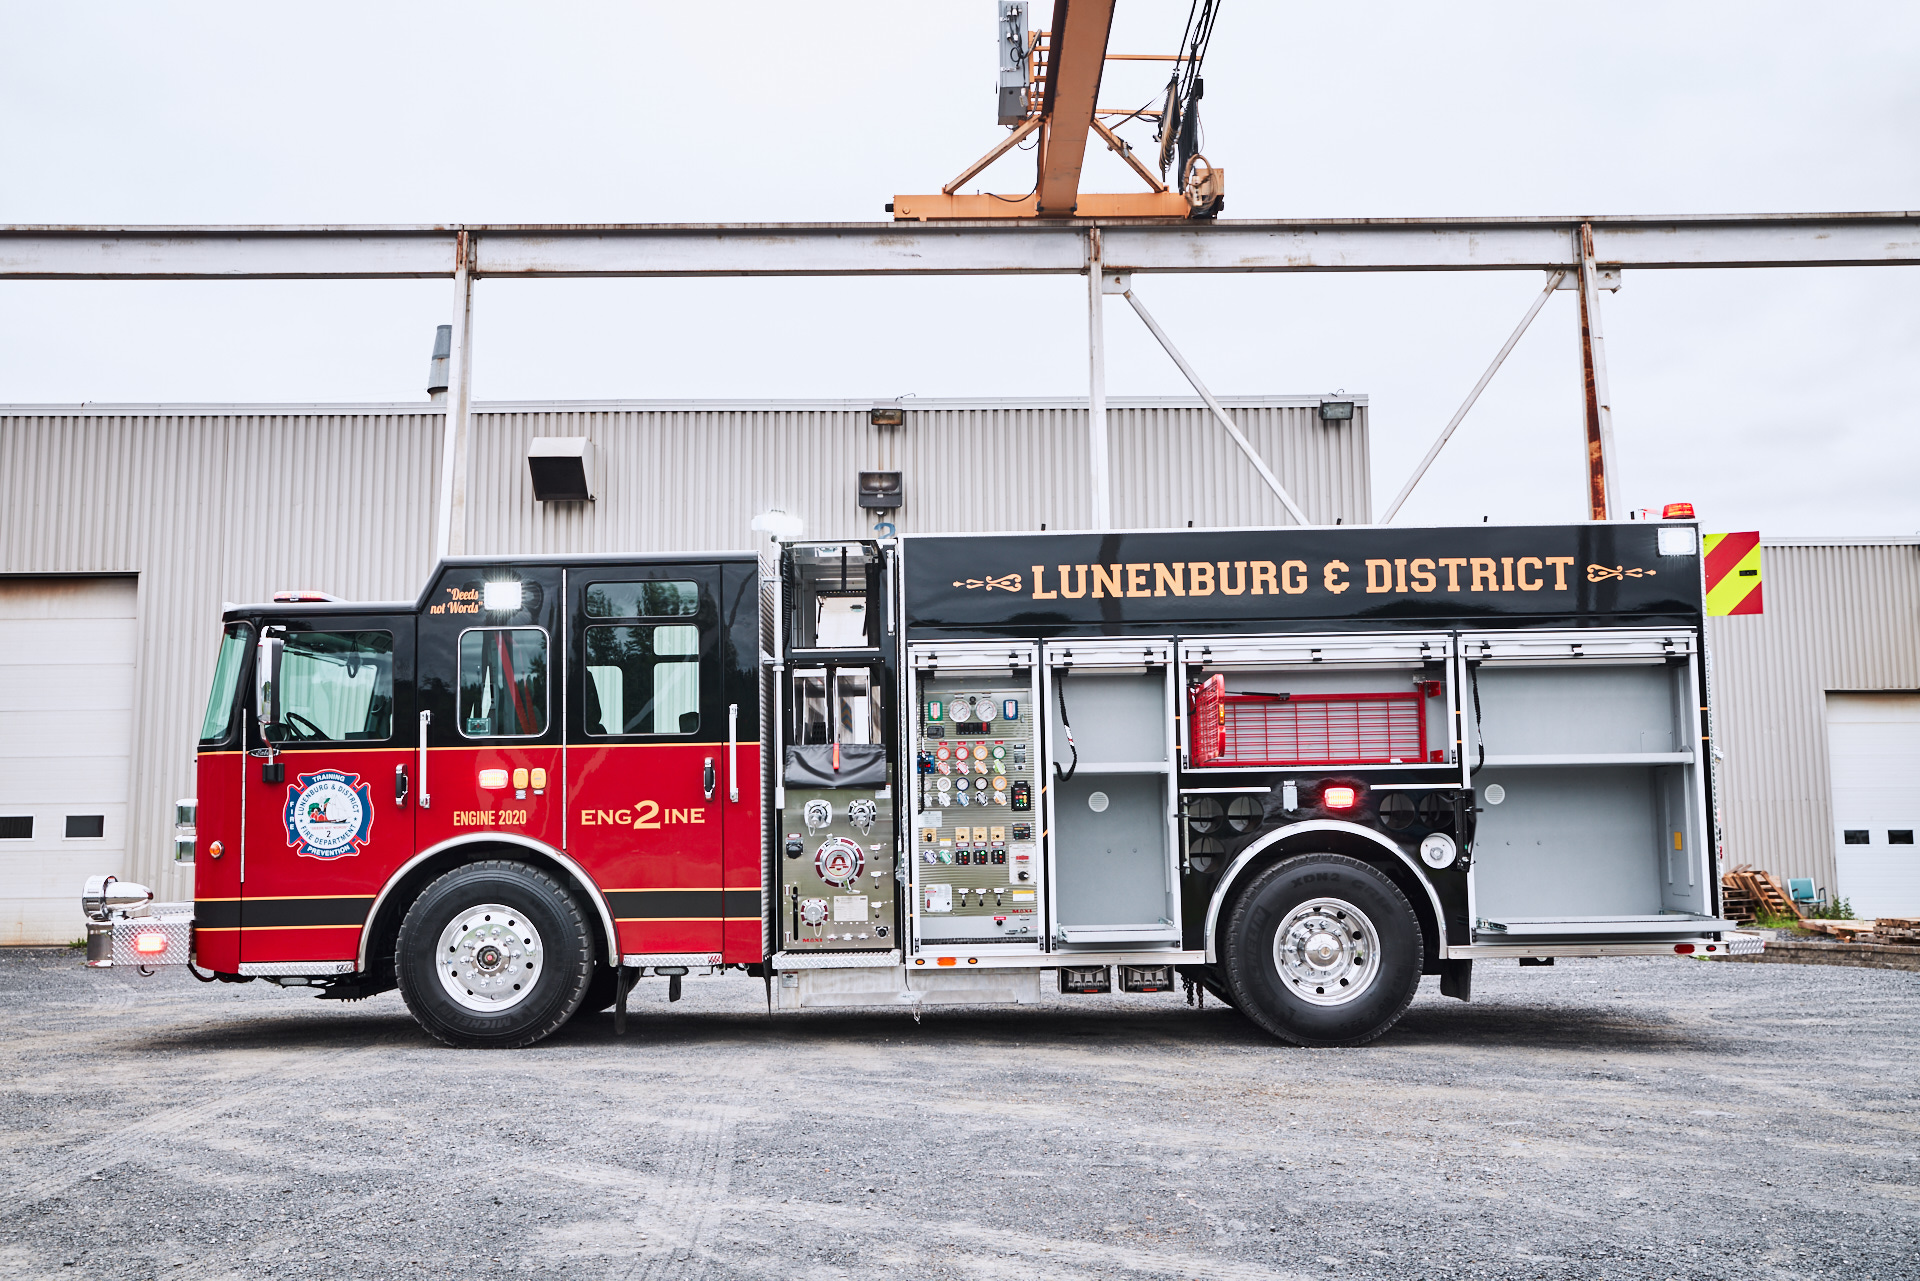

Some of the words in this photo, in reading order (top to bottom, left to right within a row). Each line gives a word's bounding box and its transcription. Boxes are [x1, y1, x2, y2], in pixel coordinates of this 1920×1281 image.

[1030, 559, 1308, 600] LUNENBURG
[1322, 559, 1350, 596] &
[1364, 555, 1575, 594] DISTRICT
[446, 587, 479, 601] "Deeds
[430, 602, 446, 615] not
[447, 600, 484, 614] Words"
[311, 773, 346, 783] TRAINING
[297, 783, 329, 816] LUNENBURG
[337, 785, 360, 814] DISTRICT
[453, 810, 496, 827] ENGINE
[498, 809, 527, 826] 2020
[300, 825, 314, 840] FIRE
[314, 823, 357, 846] DEPARTMENT
[306, 844, 351, 857] PREVENTION
[437, 1004, 512, 1029] MICHELIN
